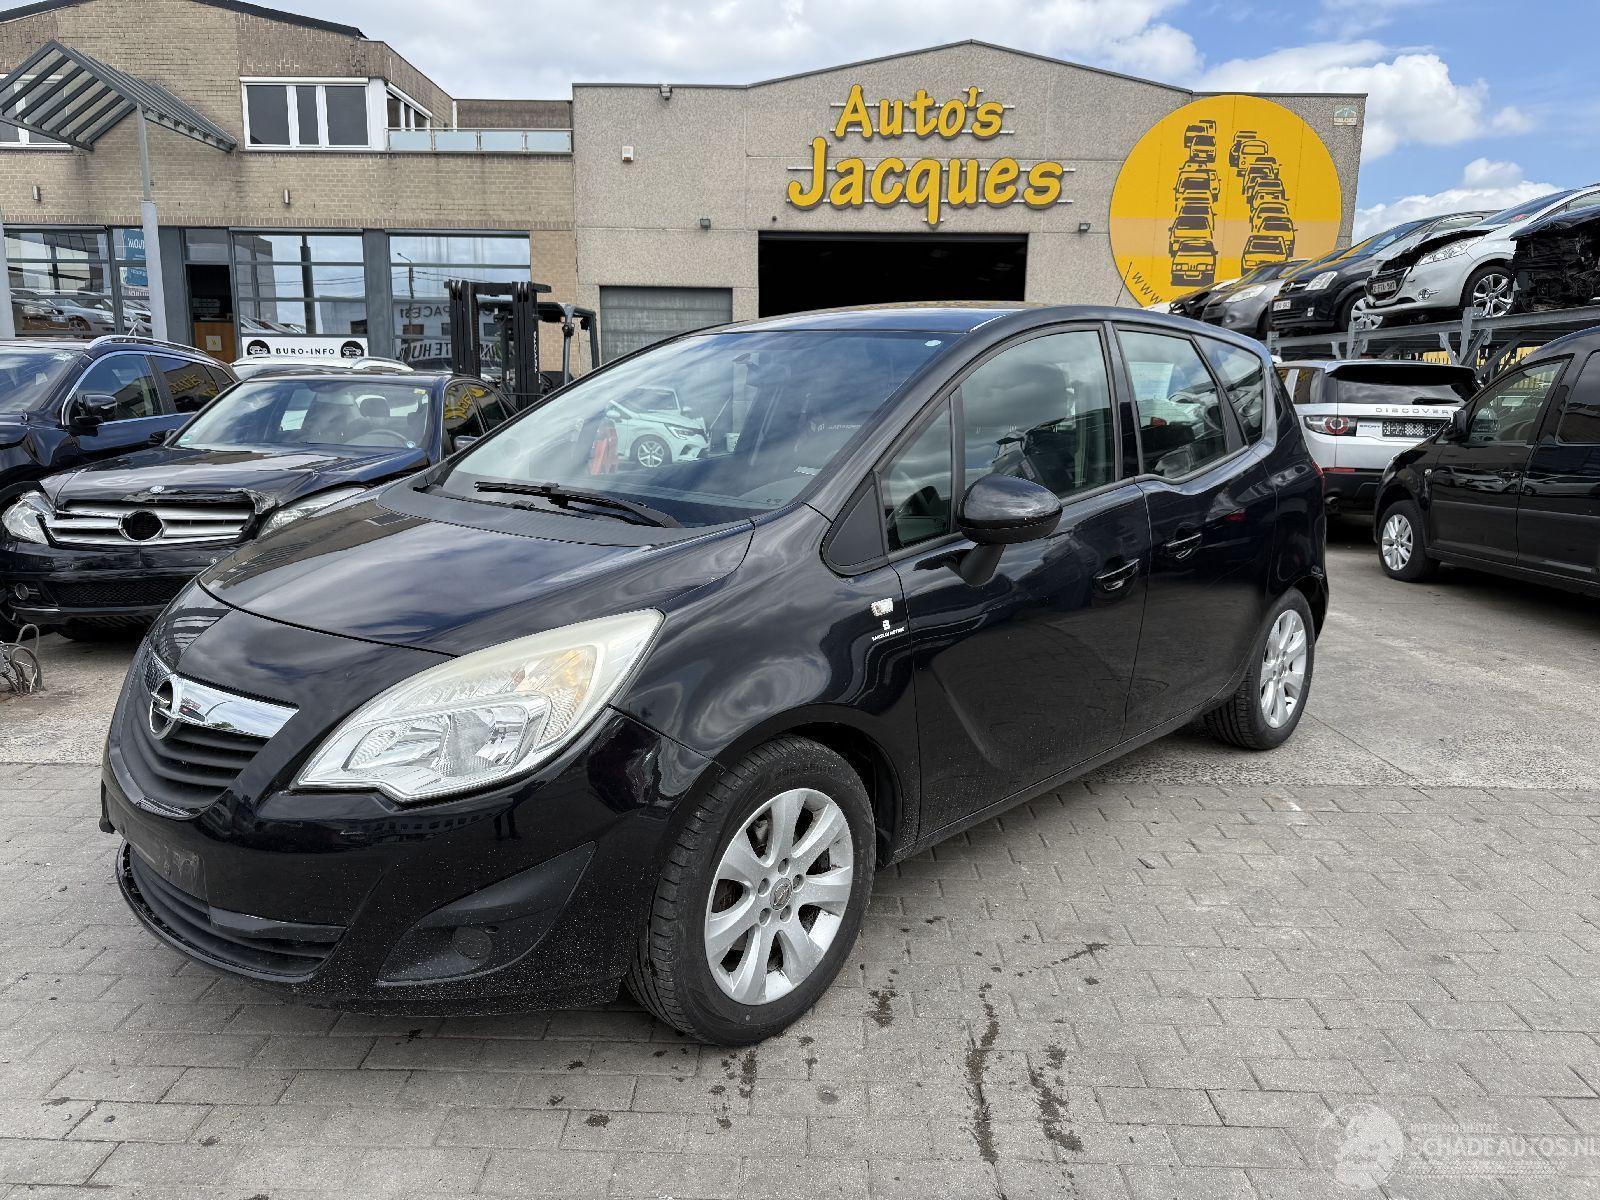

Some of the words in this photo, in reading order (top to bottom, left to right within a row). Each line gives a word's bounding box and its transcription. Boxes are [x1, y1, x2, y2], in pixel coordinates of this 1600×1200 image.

[834, 83, 1005, 141] Auto's
[786, 136, 1065, 227] Jacques
[275, 347, 335, 355] BURO-INFO
